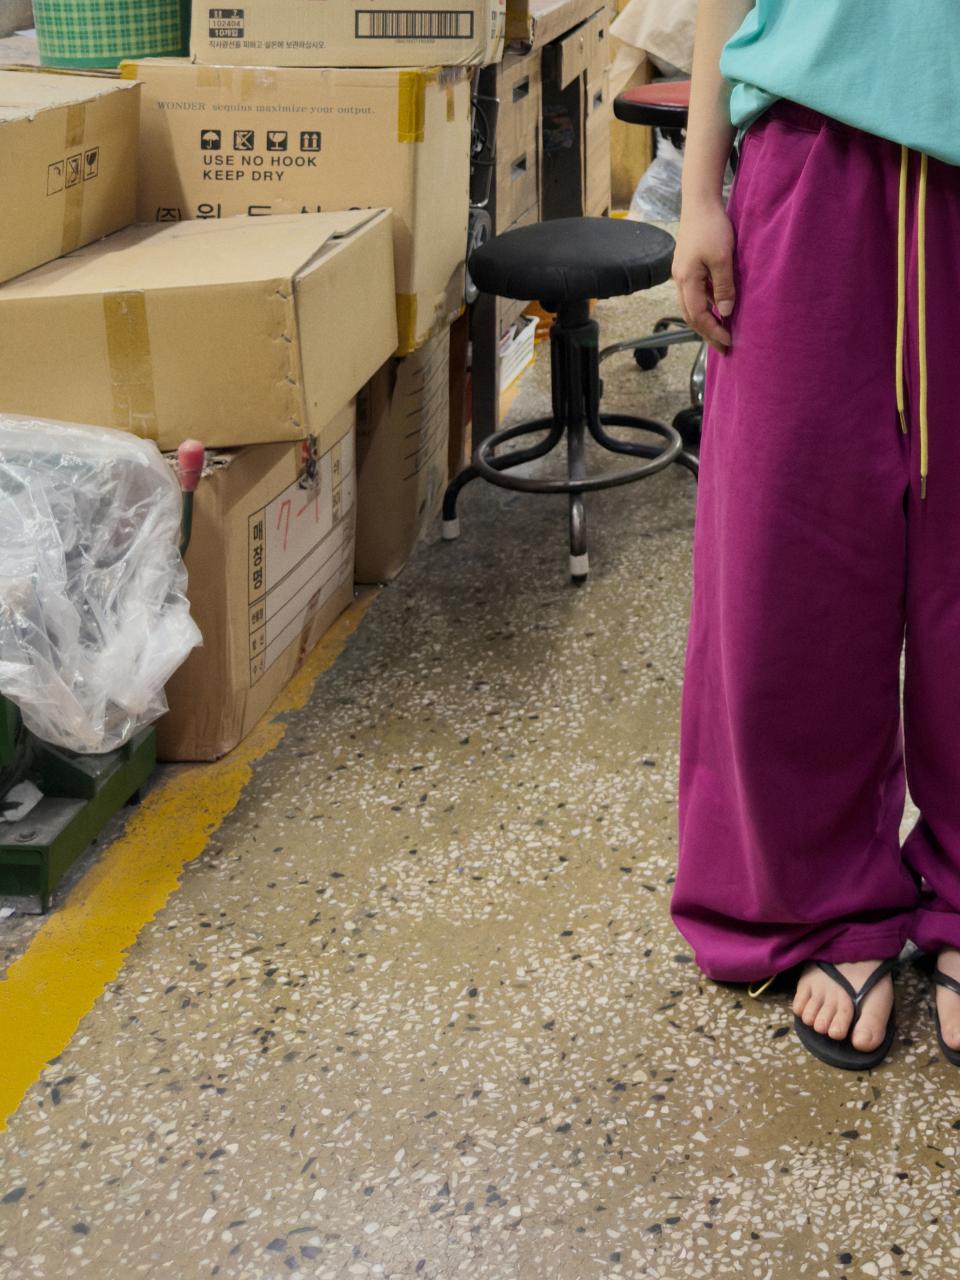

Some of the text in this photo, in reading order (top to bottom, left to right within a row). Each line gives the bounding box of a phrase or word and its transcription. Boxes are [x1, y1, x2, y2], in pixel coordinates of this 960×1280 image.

[157, 101, 206, 111] WONDER
[256, 104, 306, 114] maximize
[310, 106, 333, 115] your
[338, 106, 375, 116] output.
[203, 155, 317, 168] USE NO HOOK
[203, 170, 285, 182] KEEP DRY
